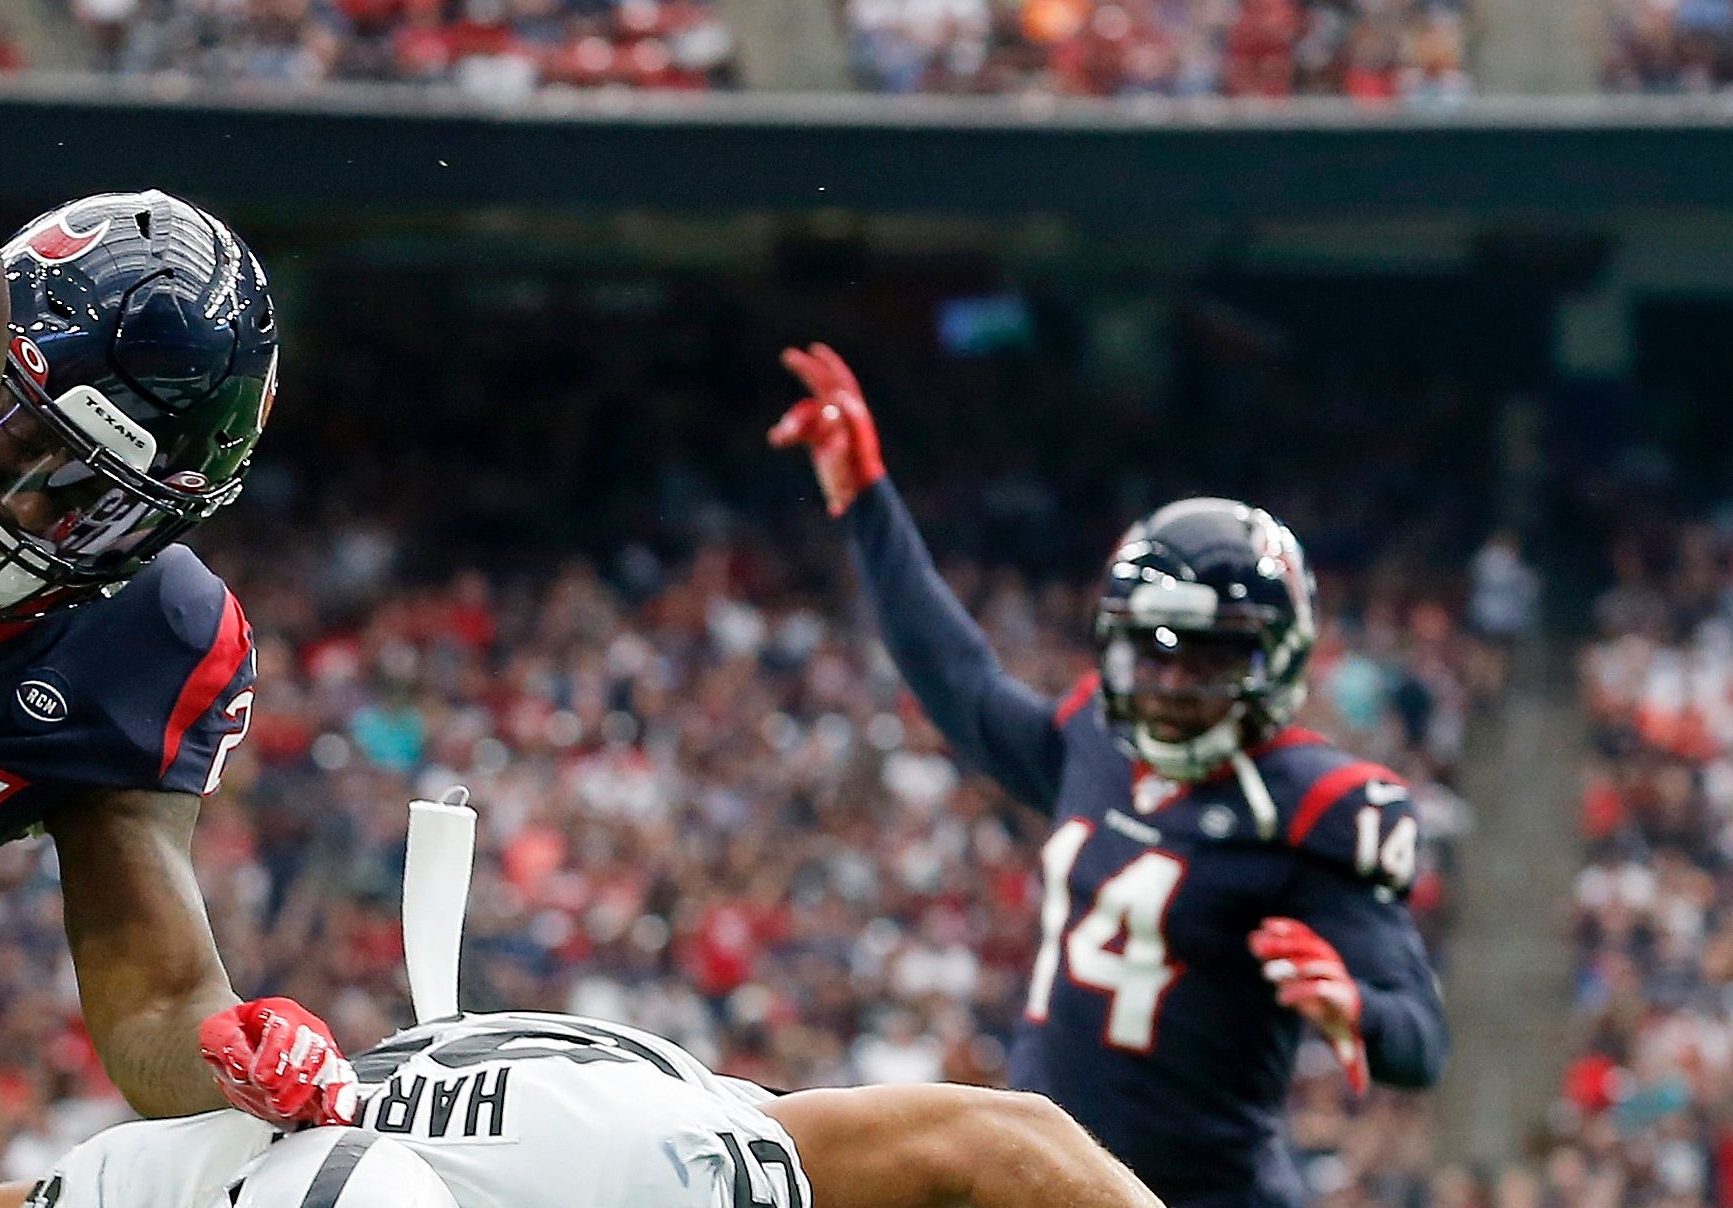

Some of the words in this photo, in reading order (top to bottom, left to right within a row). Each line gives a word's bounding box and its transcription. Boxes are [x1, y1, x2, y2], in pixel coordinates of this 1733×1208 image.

[85, 396, 146, 450] TEXANS
[25, 687, 58, 715] RCM
[1355, 805, 1417, 888] 14
[1024, 816, 1188, 1055] 14
